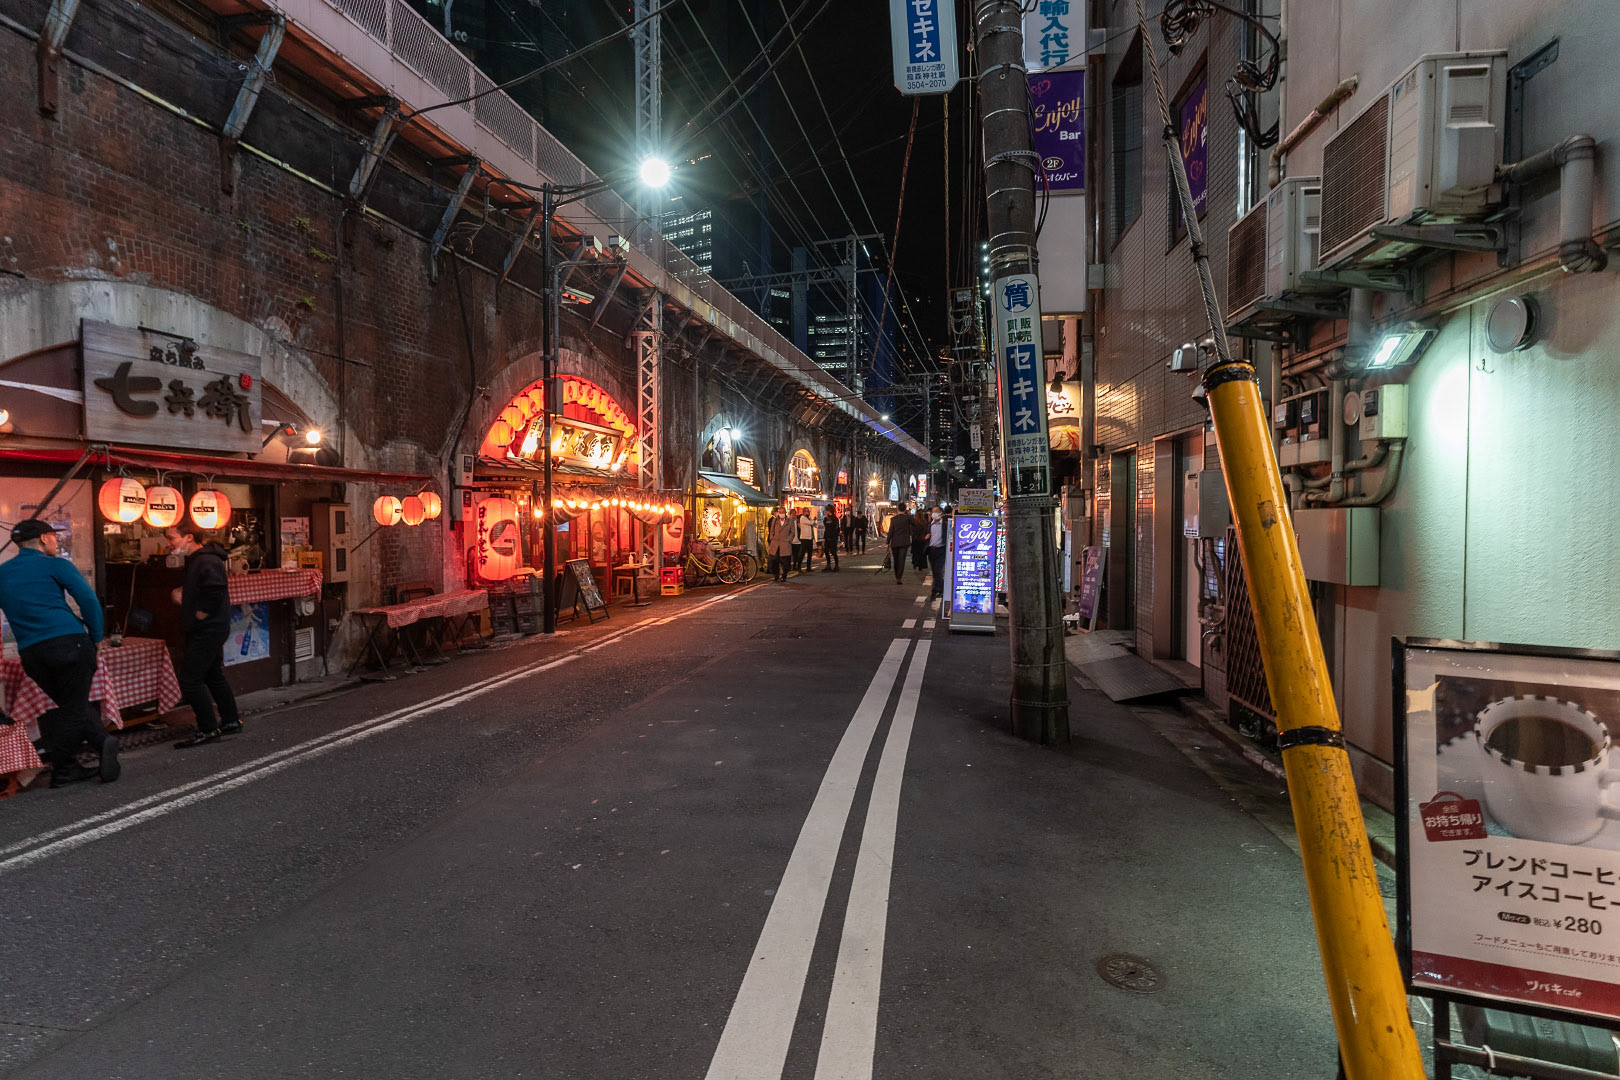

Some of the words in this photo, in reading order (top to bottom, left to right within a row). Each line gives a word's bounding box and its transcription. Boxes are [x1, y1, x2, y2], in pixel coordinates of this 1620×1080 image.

[907, 80, 947, 90] 3504-2070
[1035, 97, 1081, 132] Enjoy
[1060, 130, 1081, 141] Bar
[1047, 159, 1060, 169] 2F
[1005, 282, 1031, 311] 質
[1010, 348, 1037, 431] セキネ
[958, 524, 993, 543] Enjoy
[1425, 813, 1482, 828] お持ち帰り
[1462, 849, 1620, 886] ブレンドコーヒ
